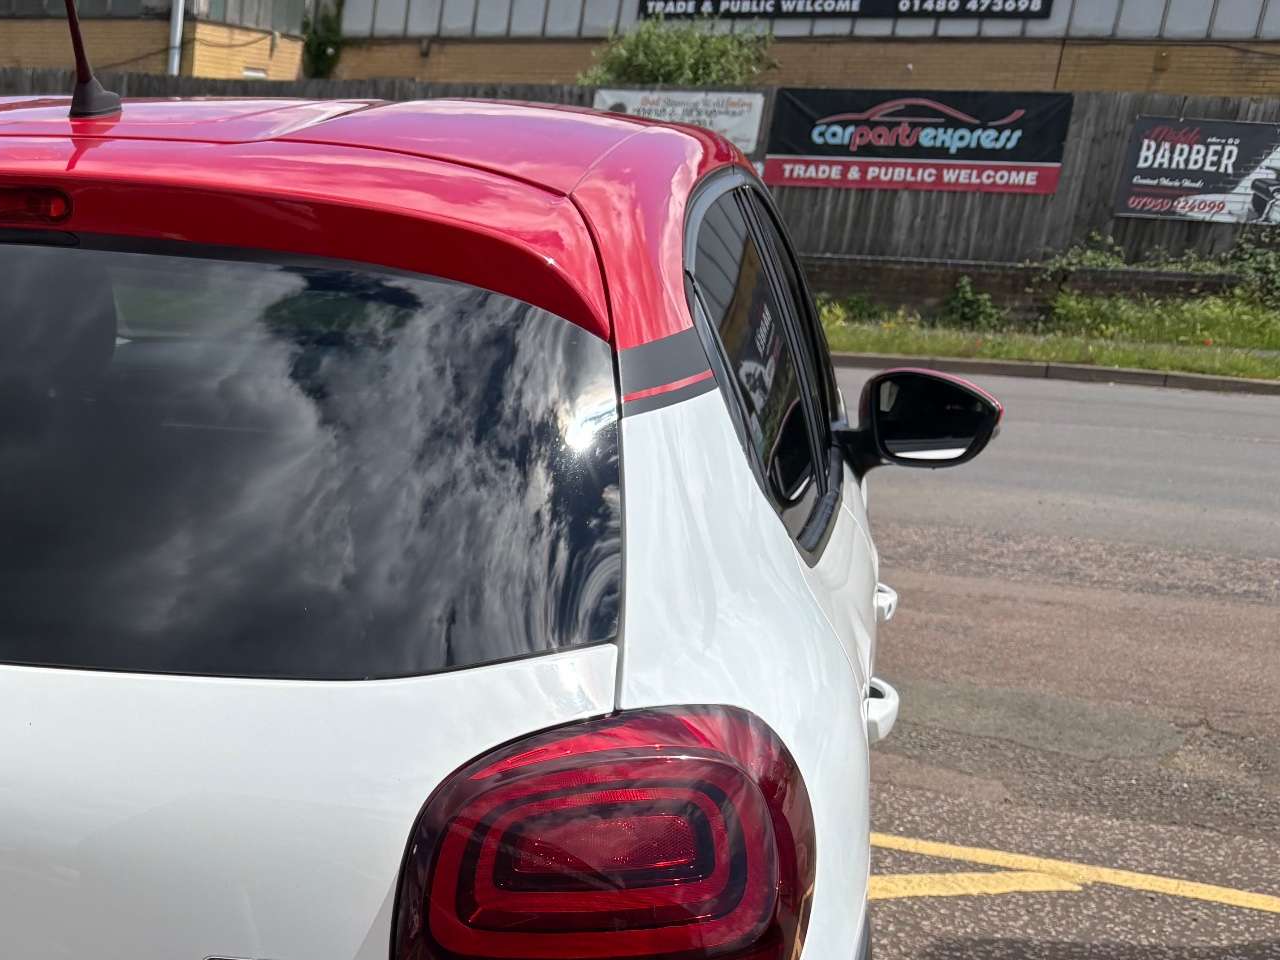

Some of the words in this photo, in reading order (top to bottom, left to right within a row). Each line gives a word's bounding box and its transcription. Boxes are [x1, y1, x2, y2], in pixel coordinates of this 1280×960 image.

[646, 0, 696, 13] TRADE
[700, 0, 713, 13] &
[719, 0, 775, 13] PUBLIC
[781, 0, 861, 12] WELCOME
[898, 0, 960, 12] 01480
[811, 122, 1023, 154] carpartsexpress
[1136, 138, 1239, 175] BARBER
[783, 163, 843, 180] TRADE
[847, 164, 861, 181] &
[867, 166, 937, 183] PUBLIC
[943, 167, 1039, 185] WELCOME
